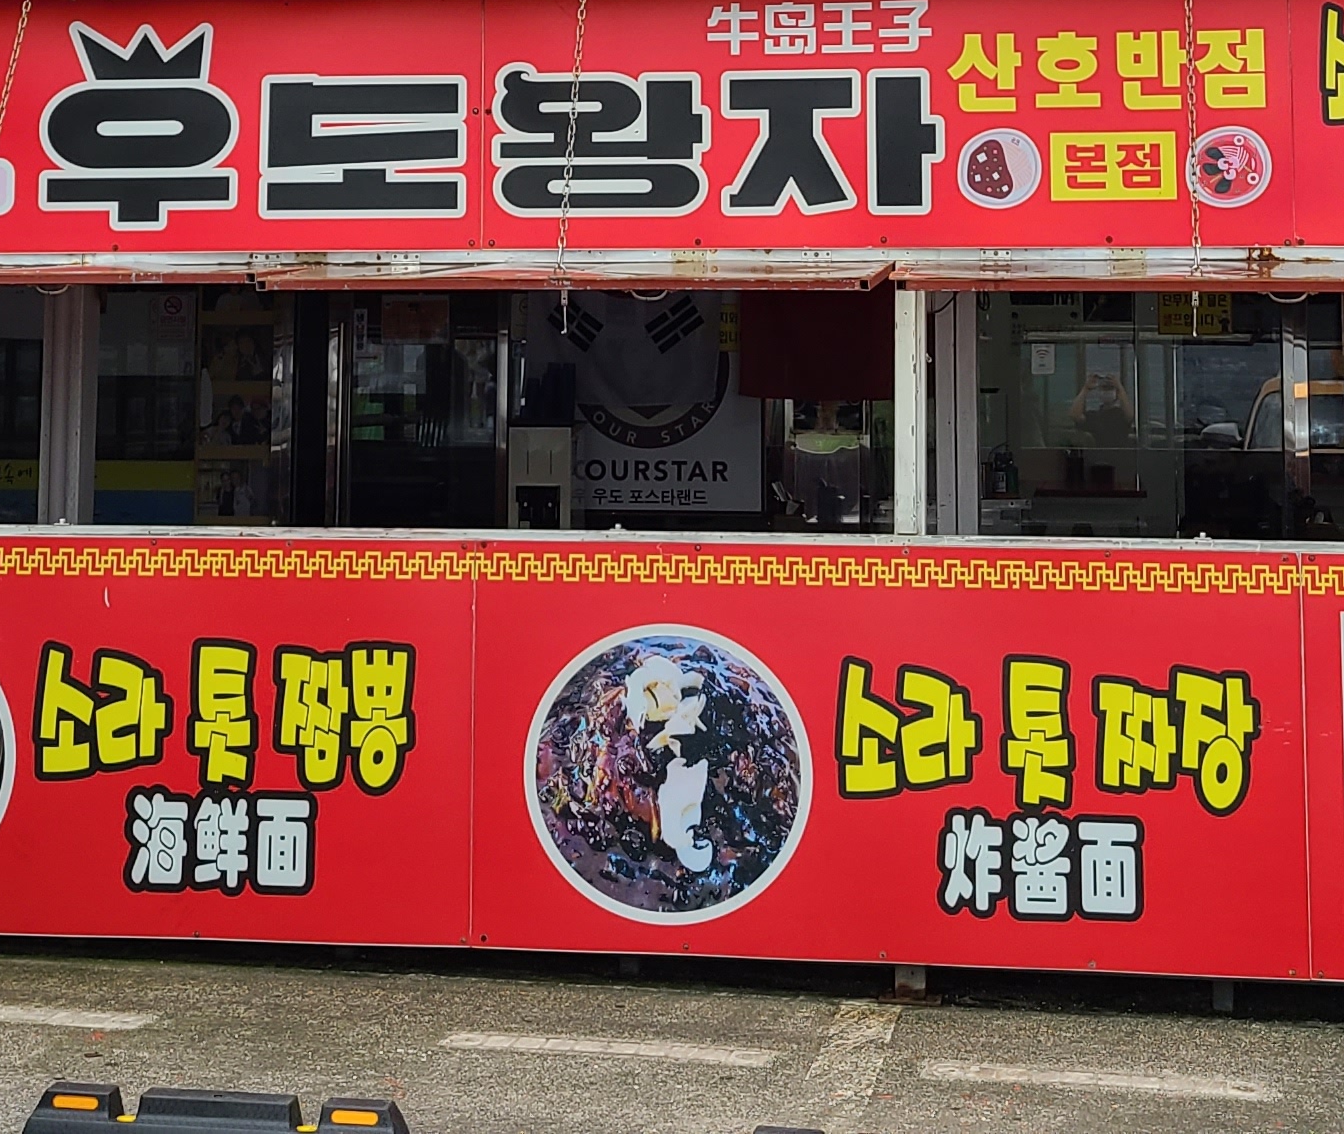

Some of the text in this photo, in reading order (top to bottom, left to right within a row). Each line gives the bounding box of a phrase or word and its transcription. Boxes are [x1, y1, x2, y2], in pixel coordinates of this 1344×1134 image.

[707, 0, 932, 56] 牛岛王子
[948, 29, 1266, 112] 산호반점
[45, 72, 937, 228] 우도왕자
[1064, 144, 1164, 190] 본점
[660, 401, 717, 445] STAR
[592, 488, 708, 506] 우도 포스타랜드
[40, 645, 409, 788] 소라 톳 짬뽕
[842, 662, 1256, 812] 소라 톳 짜장
[131, 791, 310, 888] 海鲜面
